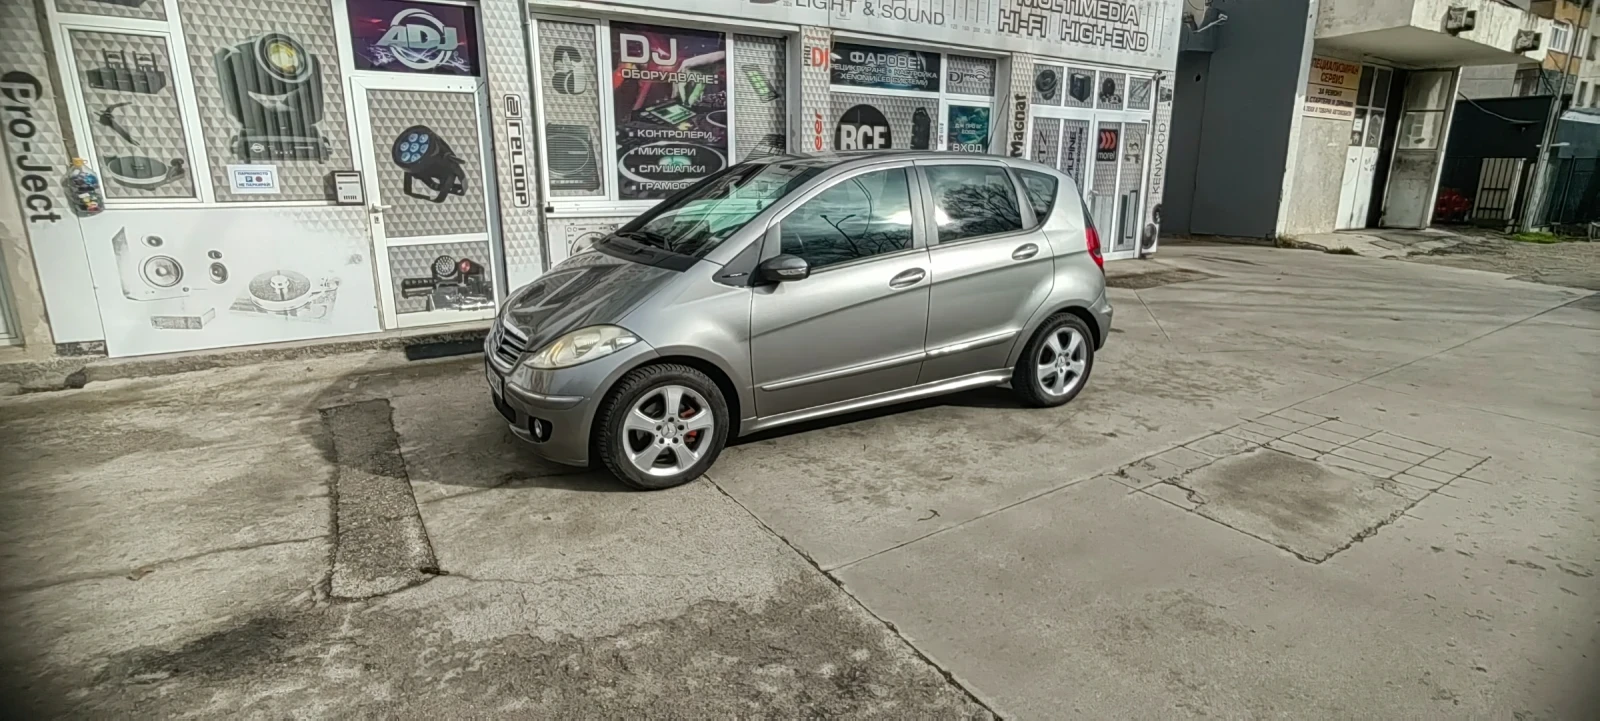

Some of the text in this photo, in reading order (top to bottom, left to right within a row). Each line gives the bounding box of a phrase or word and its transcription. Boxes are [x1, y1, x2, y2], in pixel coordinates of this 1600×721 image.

[863, 1, 876, 16] &
[881, 4, 945, 26] SOUND
[374, 24, 458, 51] ADJ
[998, 9, 1149, 51] HI-FI HIGH-END
[620, 33, 677, 66] DJ
[812, 46, 829, 72] DJ
[850, 51, 921, 69] ФАРОВЕ:
[1312, 58, 1359, 75] ПЕЦИАЛИЗИРАН
[621, 69, 719, 85] ОБОРУДВАНЕ:
[1321, 72, 1344, 85] СЕРВИЗ
[637, 129, 713, 139] КОНТРОЛЕРИ
[814, 109, 823, 152] eer
[1, 71, 62, 223] Pro-Ject
[638, 147, 696, 156] МИКСЕРИ
[953, 143, 983, 153] ВХОД
[1067, 131, 1077, 177] ALPINE
[1097, 151, 1115, 159] morel
[1152, 123, 1166, 195] KENWOOD
[639, 164, 706, 173] СЛУШАЛКИ
[640, 182, 694, 190] ГРАМОФ
